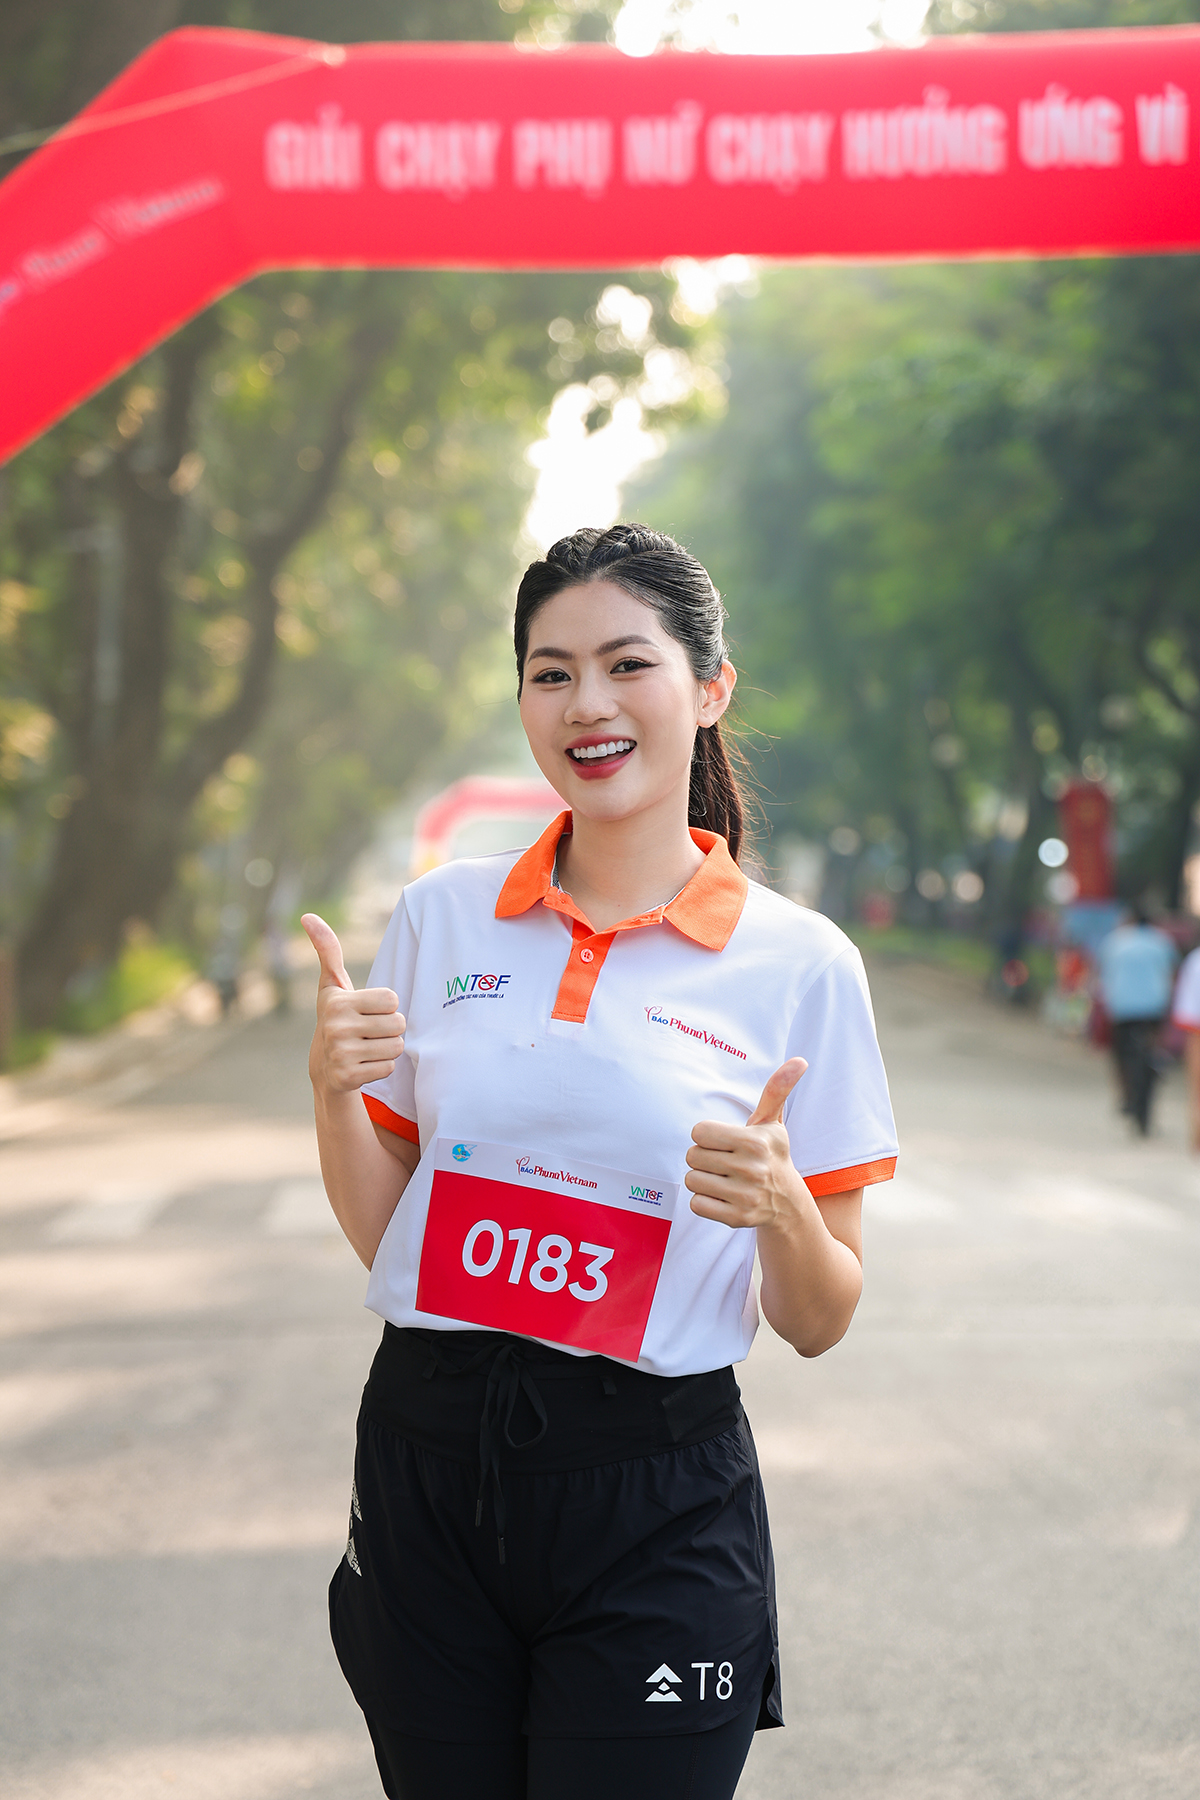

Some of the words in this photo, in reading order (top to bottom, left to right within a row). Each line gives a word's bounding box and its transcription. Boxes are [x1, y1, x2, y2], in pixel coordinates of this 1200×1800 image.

[376, 120, 499, 201] CHẠY
[513, 118, 613, 199] PHỤ
[706, 112, 833, 195] CHẠY
[462, 1219, 615, 1302] 0183
[691, 1661, 734, 1701] T8
